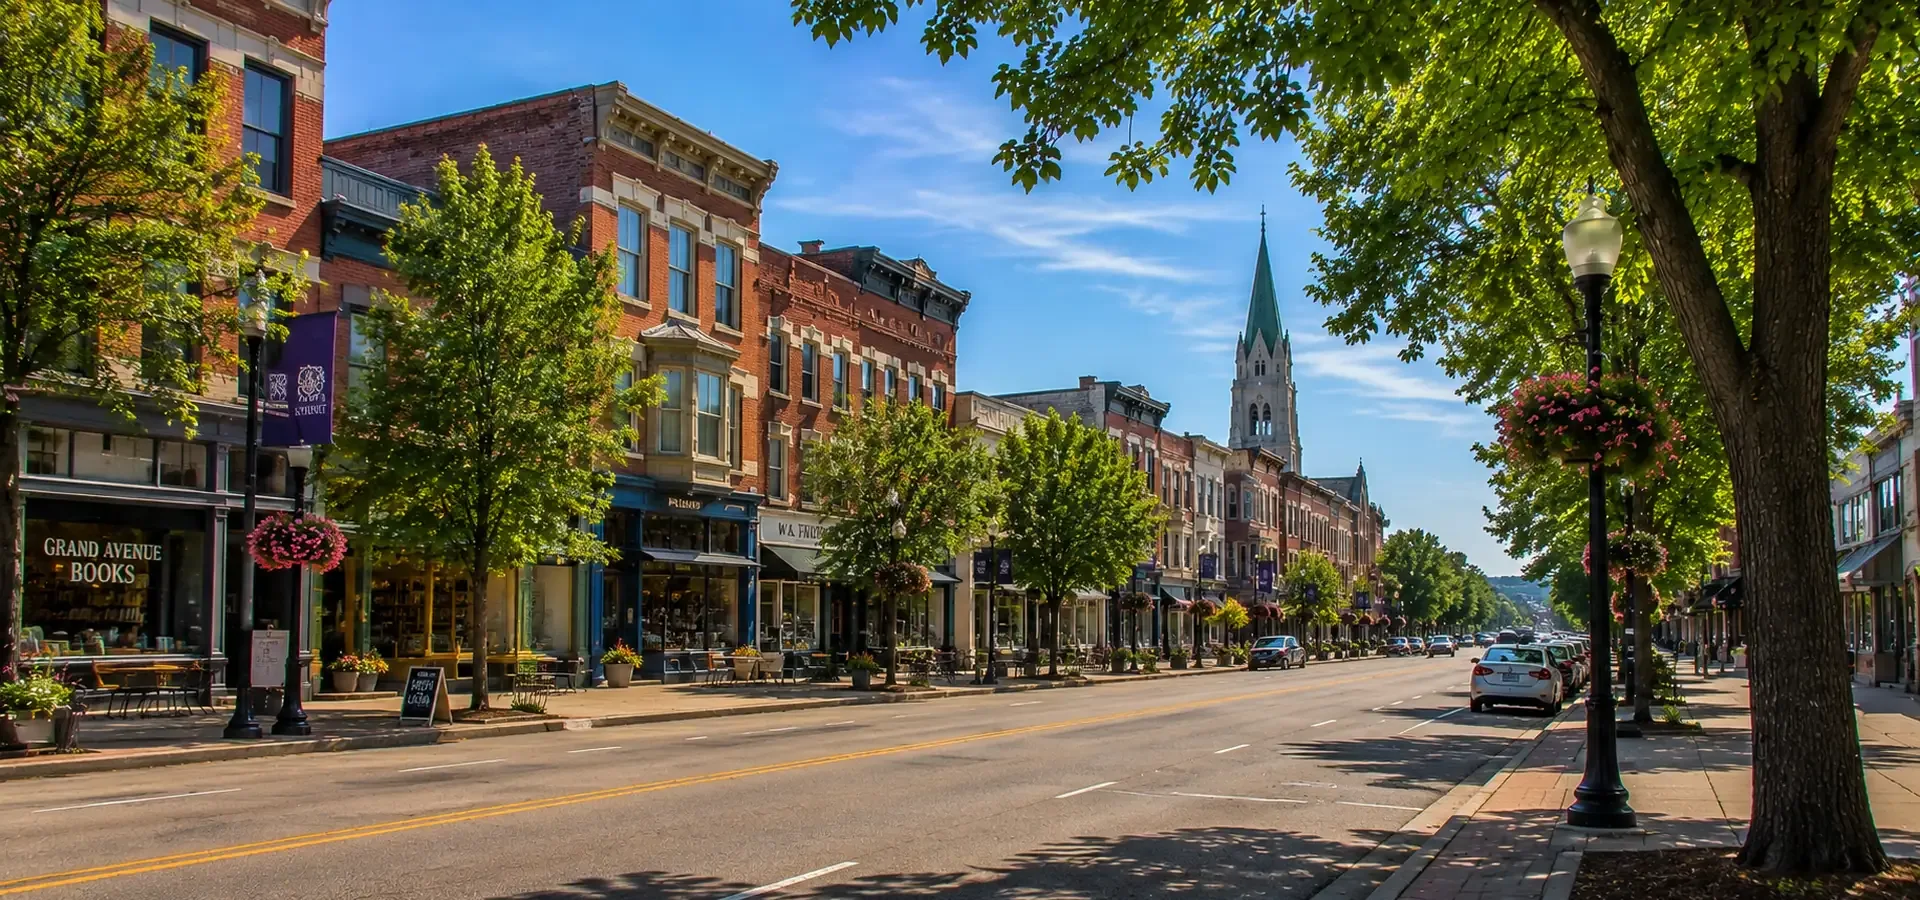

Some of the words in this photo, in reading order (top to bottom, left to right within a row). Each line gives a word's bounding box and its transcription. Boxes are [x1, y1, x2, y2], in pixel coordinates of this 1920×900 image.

[44, 537, 99, 557] GRAND
[103, 542, 162, 561] AVENUE
[70, 562, 135, 584] BOOKS
